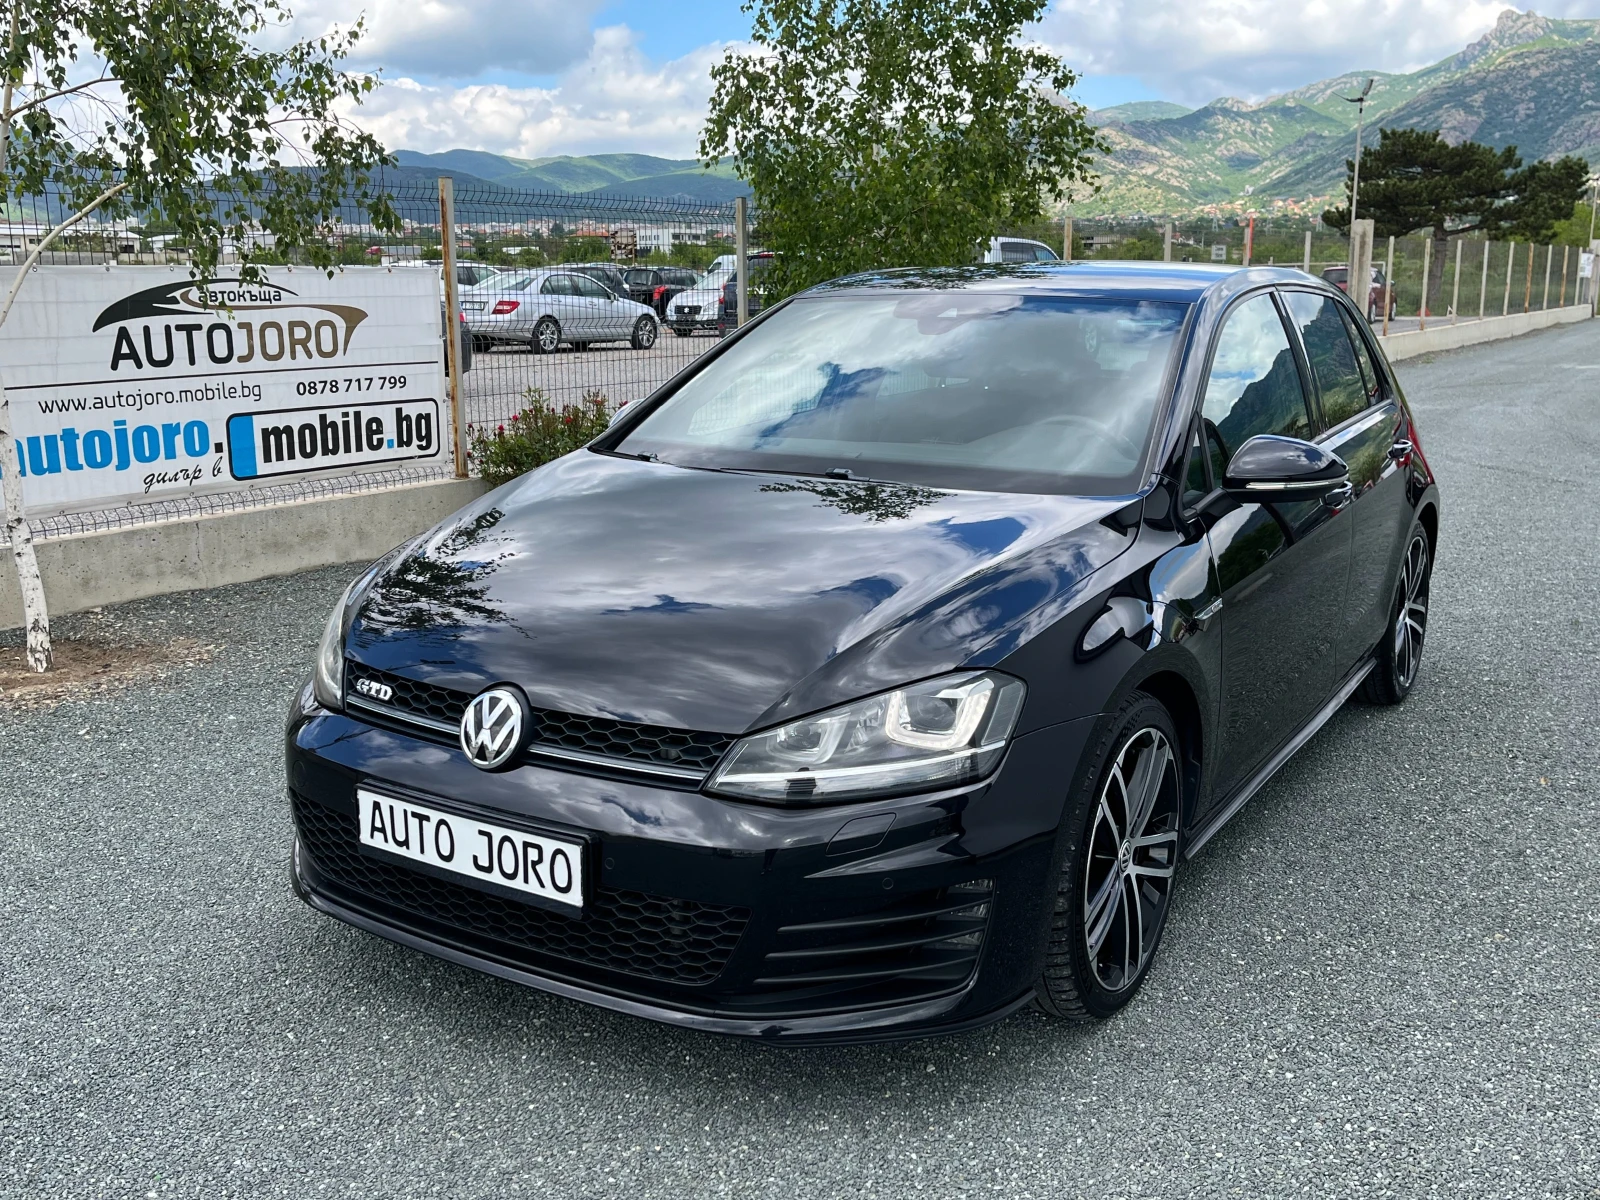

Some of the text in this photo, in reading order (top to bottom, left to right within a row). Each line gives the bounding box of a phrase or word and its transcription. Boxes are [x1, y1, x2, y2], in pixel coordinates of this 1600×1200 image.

[198, 290, 283, 305] автокъща
[38, 375, 407, 414] www.autojoro.mobile.bg 0878 717 799
[261, 407, 432, 463] mobile.bg
[143, 464, 204, 494] дилър
[356, 678, 393, 700] GTD
[370, 800, 573, 894] AUTO JORO
